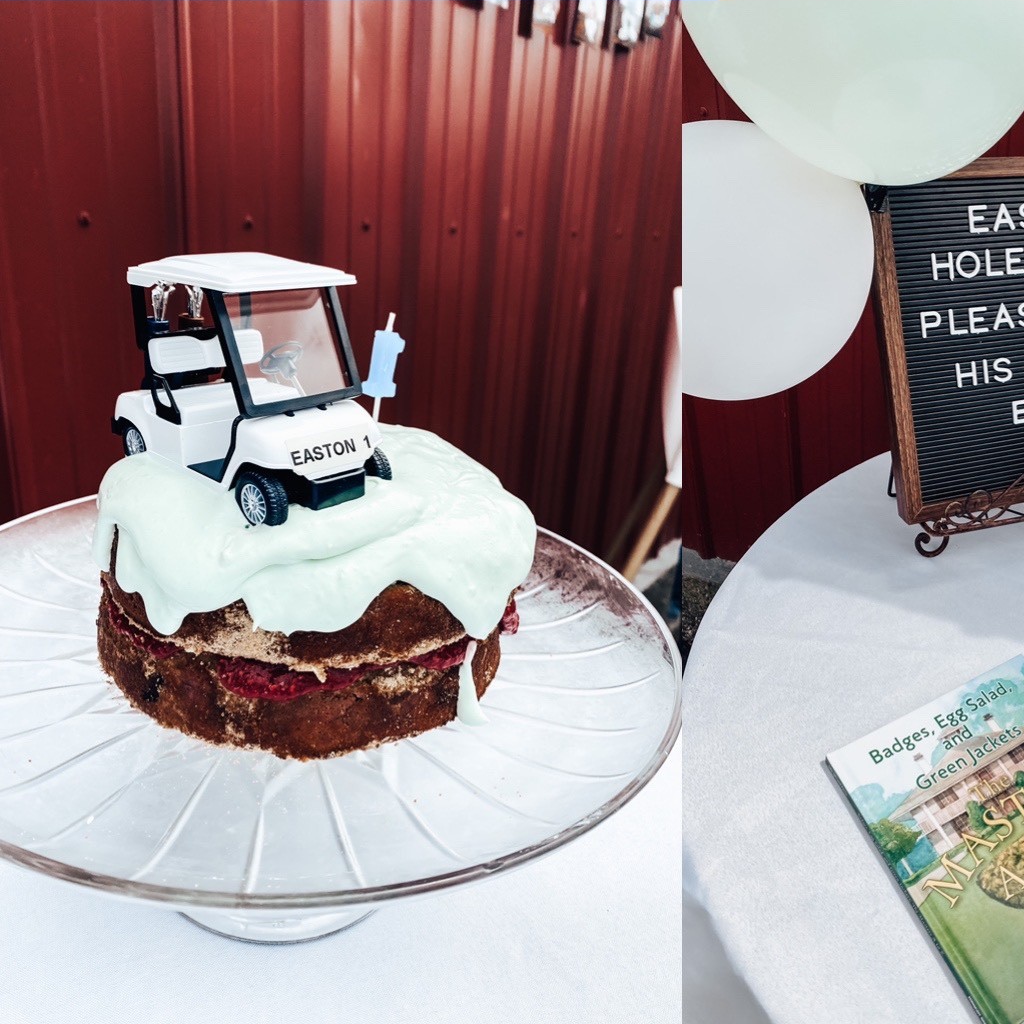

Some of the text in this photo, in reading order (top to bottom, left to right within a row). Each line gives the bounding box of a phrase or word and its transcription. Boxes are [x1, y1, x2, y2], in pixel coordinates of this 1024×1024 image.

[954, 356, 1014, 389] HIS
[290, 435, 372, 467] EASTON 1
[868, 681, 1013, 765] Badges, Egg Salad,
[942, 725, 973, 751] and
[915, 725, 1022, 791] Green Jackets
[968, 776, 1012, 801] The
